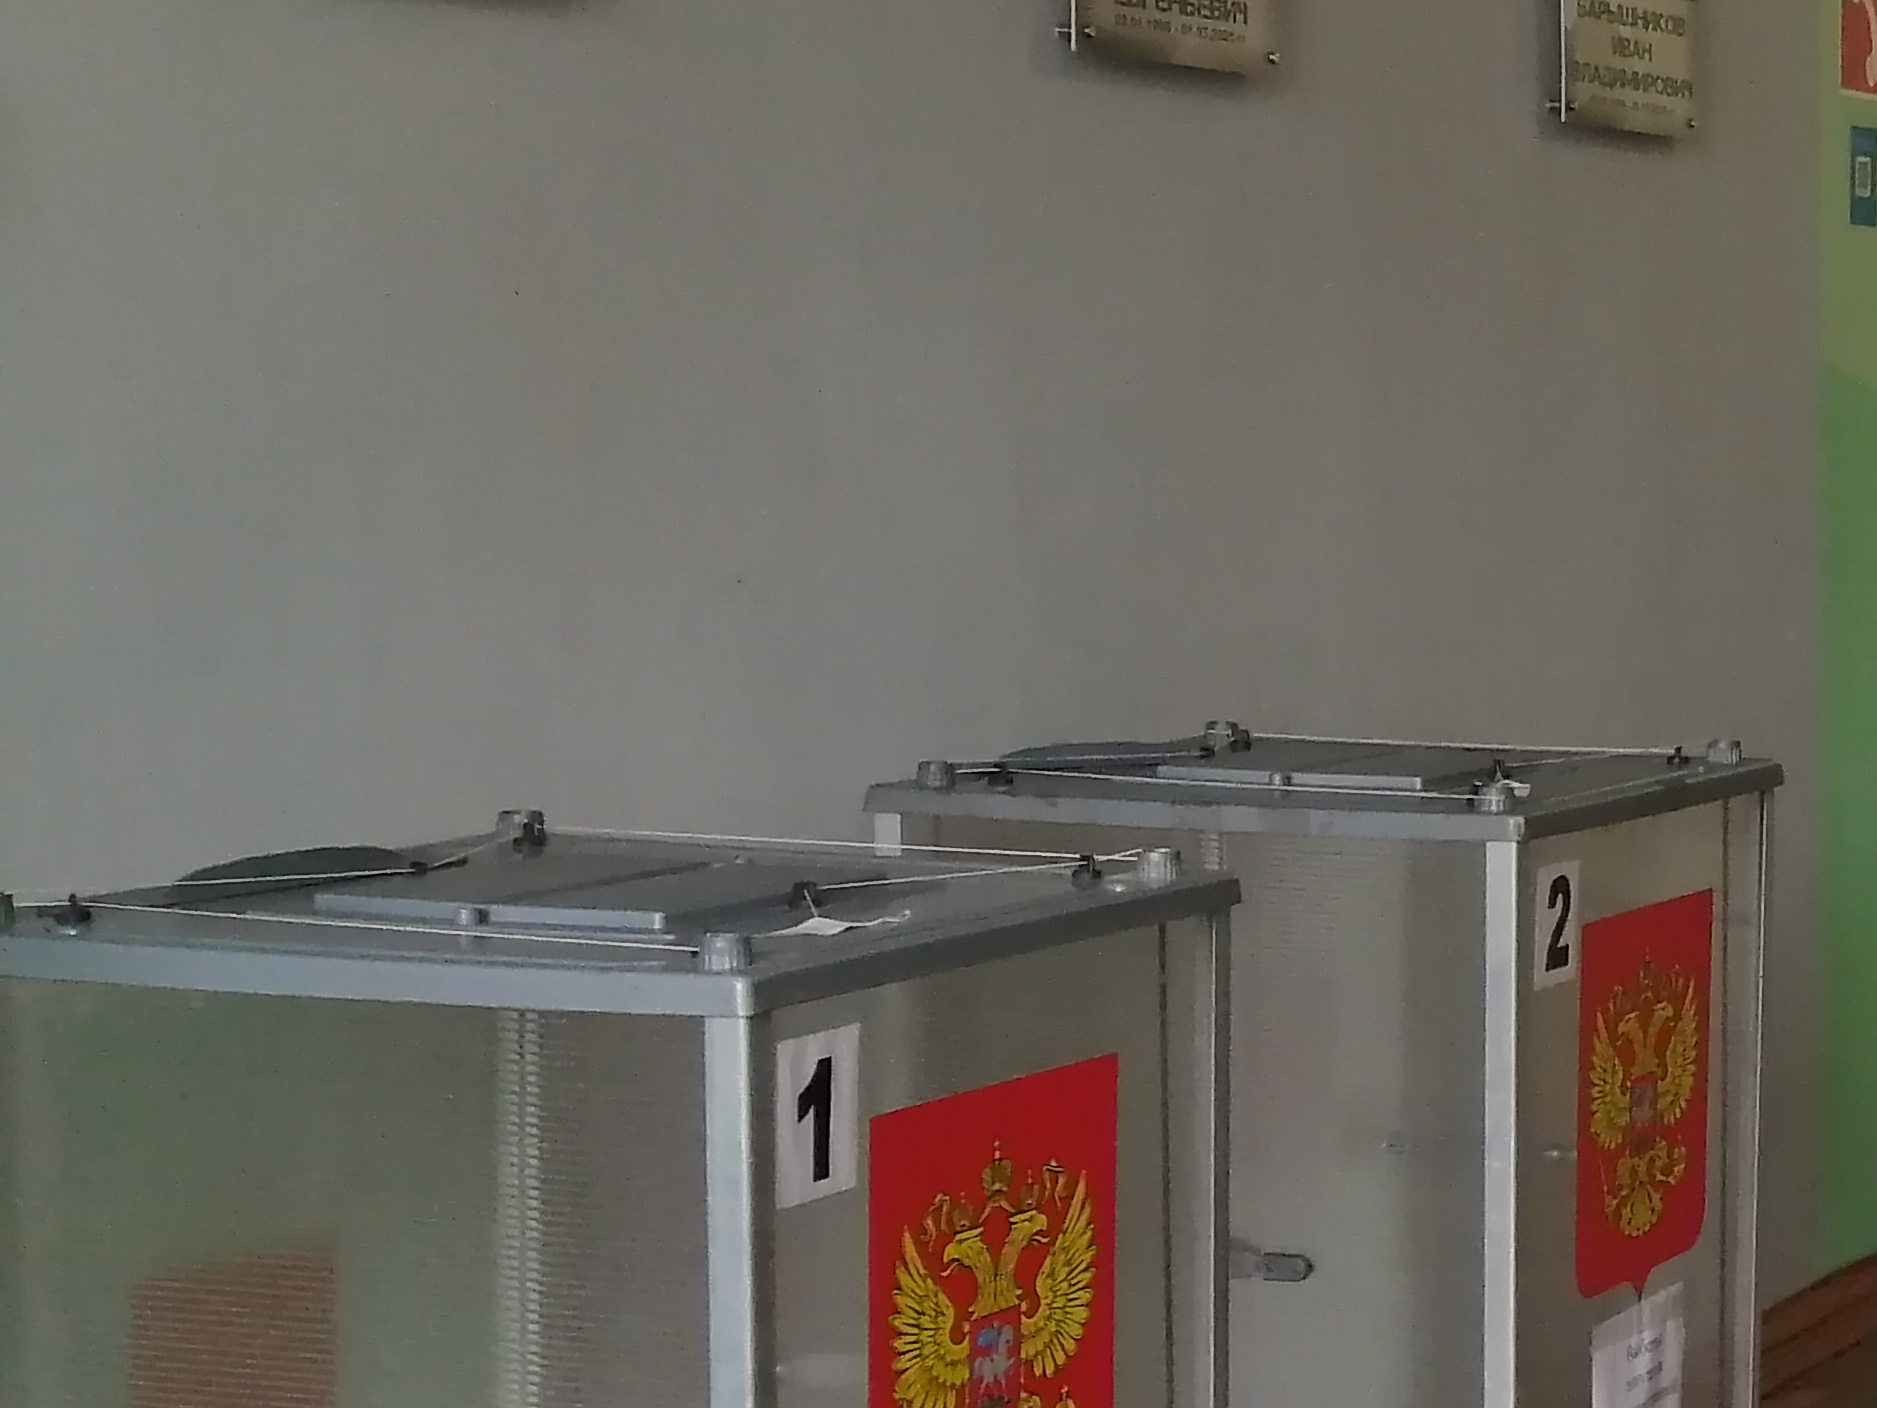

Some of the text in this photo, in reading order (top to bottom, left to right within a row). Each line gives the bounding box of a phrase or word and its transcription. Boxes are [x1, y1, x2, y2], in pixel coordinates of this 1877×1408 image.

[1612, 35, 1652, 62] ИВАН
[1545, 876, 1573, 971] 2
[797, 1057, 832, 1182] 1
